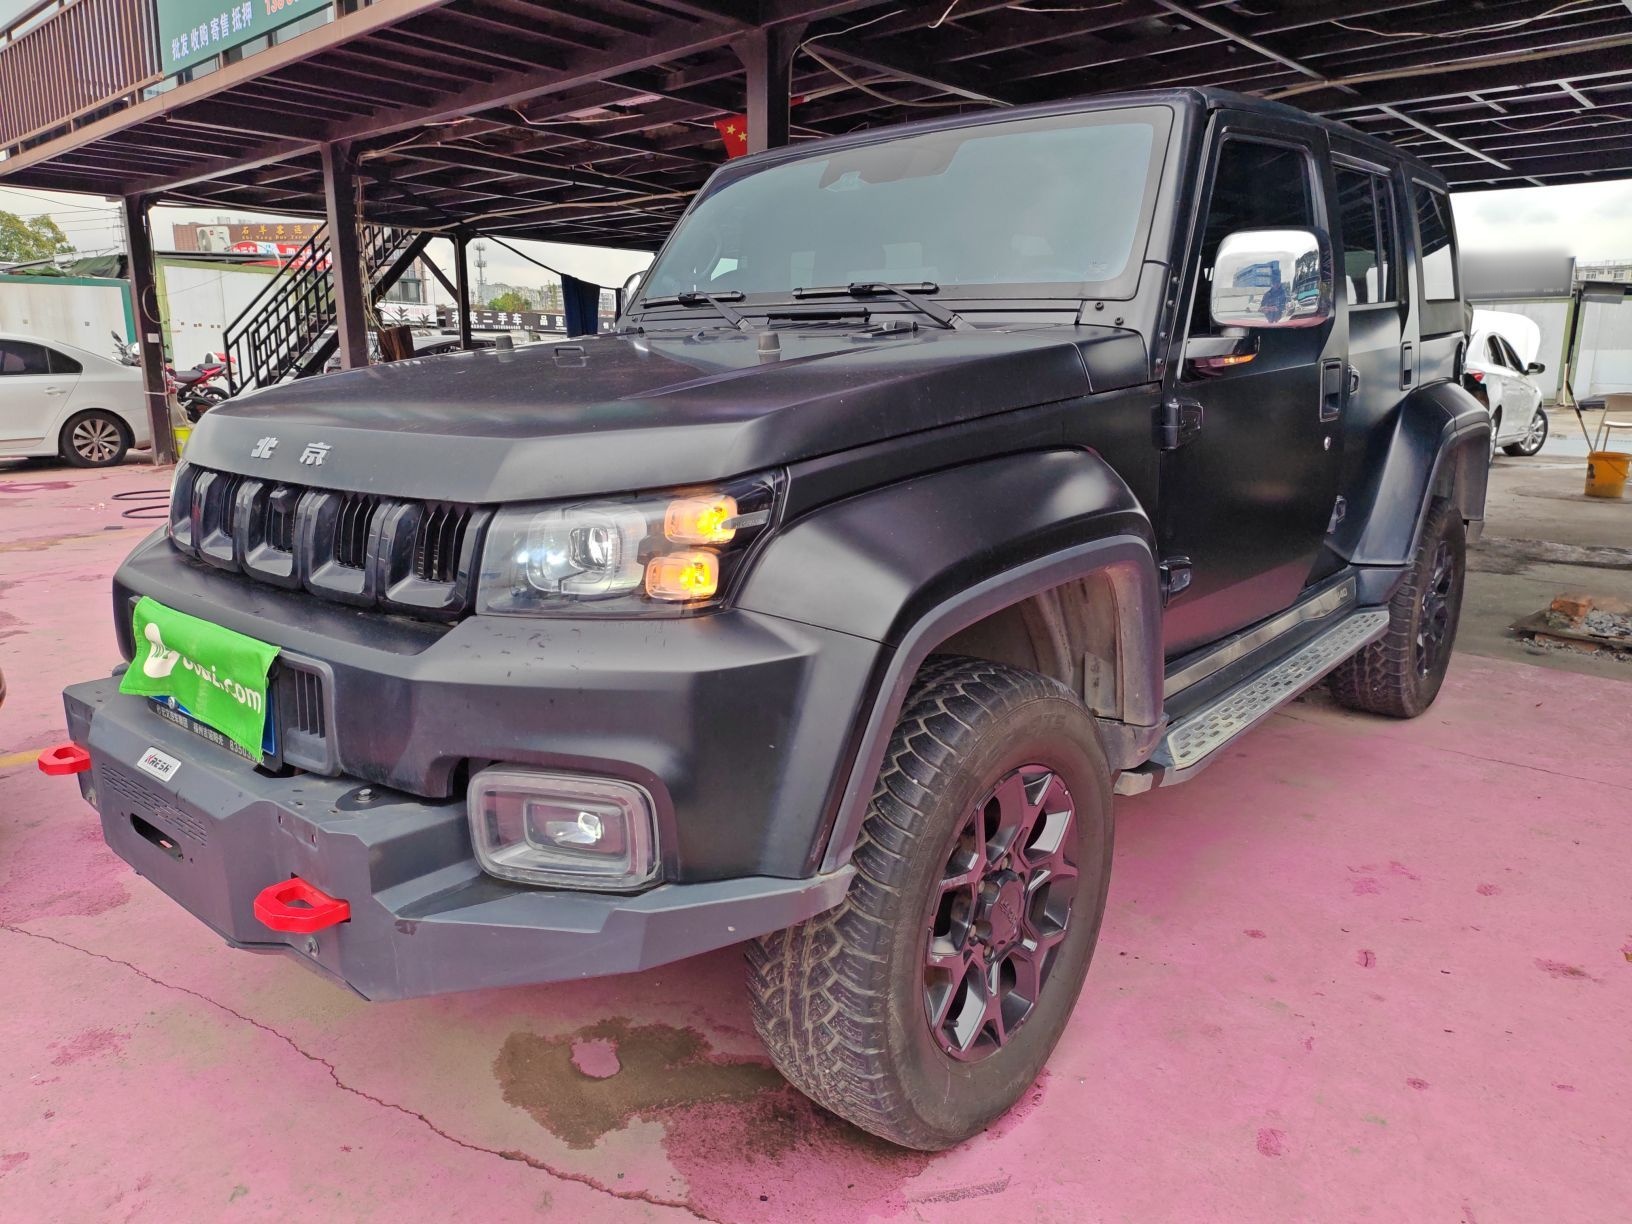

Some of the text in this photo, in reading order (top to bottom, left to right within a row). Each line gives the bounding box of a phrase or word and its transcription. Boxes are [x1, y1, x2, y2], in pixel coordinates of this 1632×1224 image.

[172, 2, 253, 61] 批发 收购 寄售 抵押
[251, 436, 332, 466] 北京
